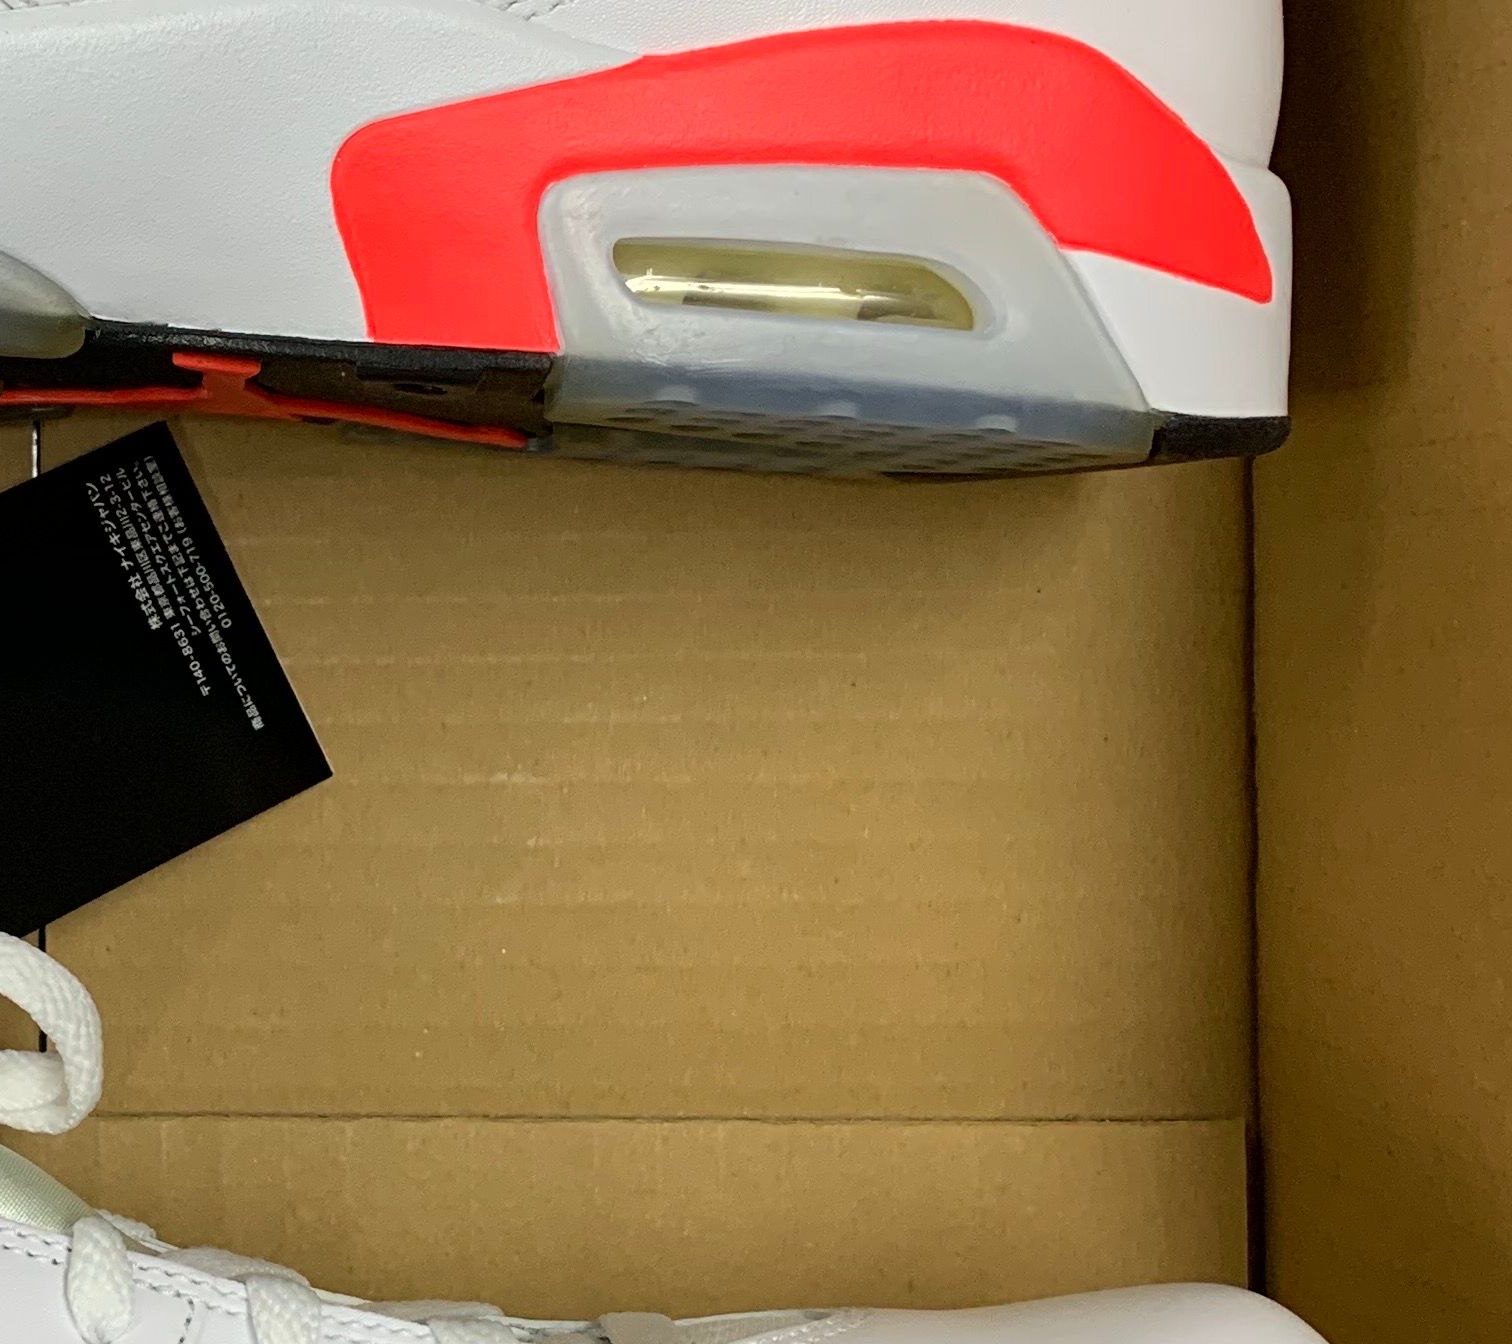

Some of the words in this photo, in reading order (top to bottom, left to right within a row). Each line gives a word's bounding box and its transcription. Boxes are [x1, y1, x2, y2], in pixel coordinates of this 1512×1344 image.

[86, 483, 133, 570] ナイキジャパン
[128, 573, 162, 630] 株式会社
[183, 537, 231, 628] 0120-500-719
